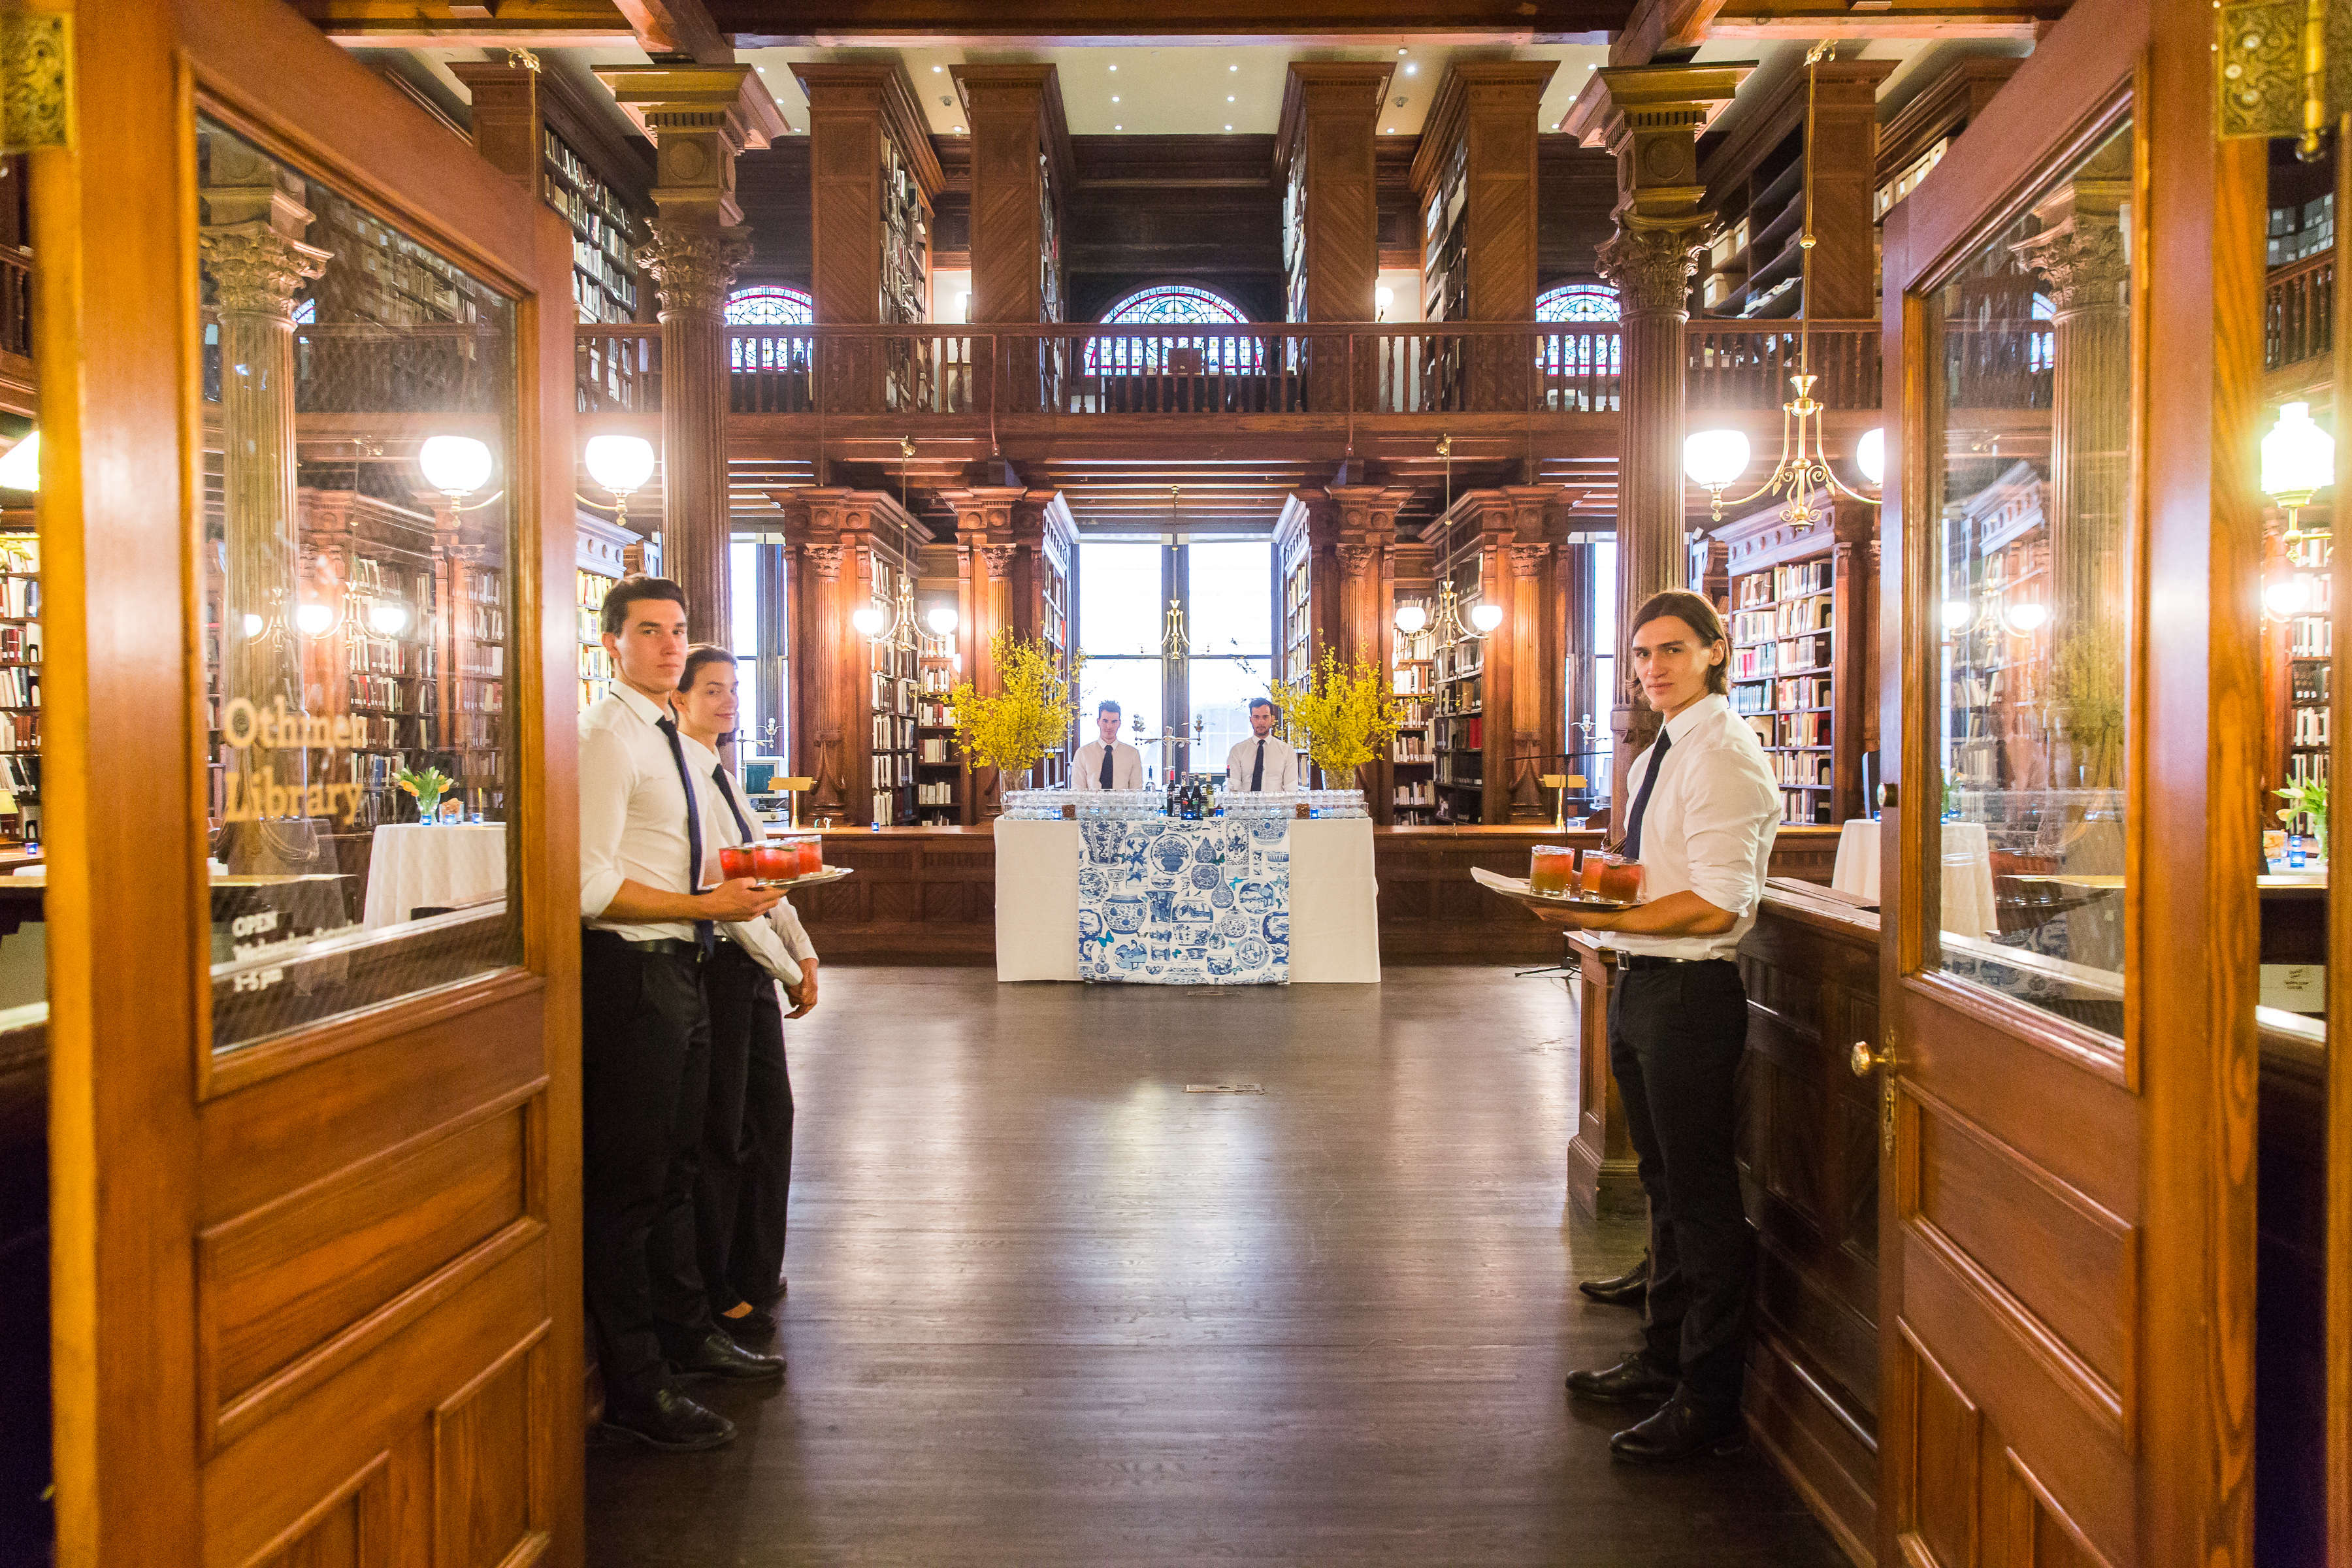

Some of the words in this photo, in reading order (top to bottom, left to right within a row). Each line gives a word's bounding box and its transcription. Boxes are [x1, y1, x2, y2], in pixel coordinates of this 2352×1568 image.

[224, 694, 368, 748] Othmer
[225, 765, 365, 826] Library
[232, 911, 278, 938] OPEN
